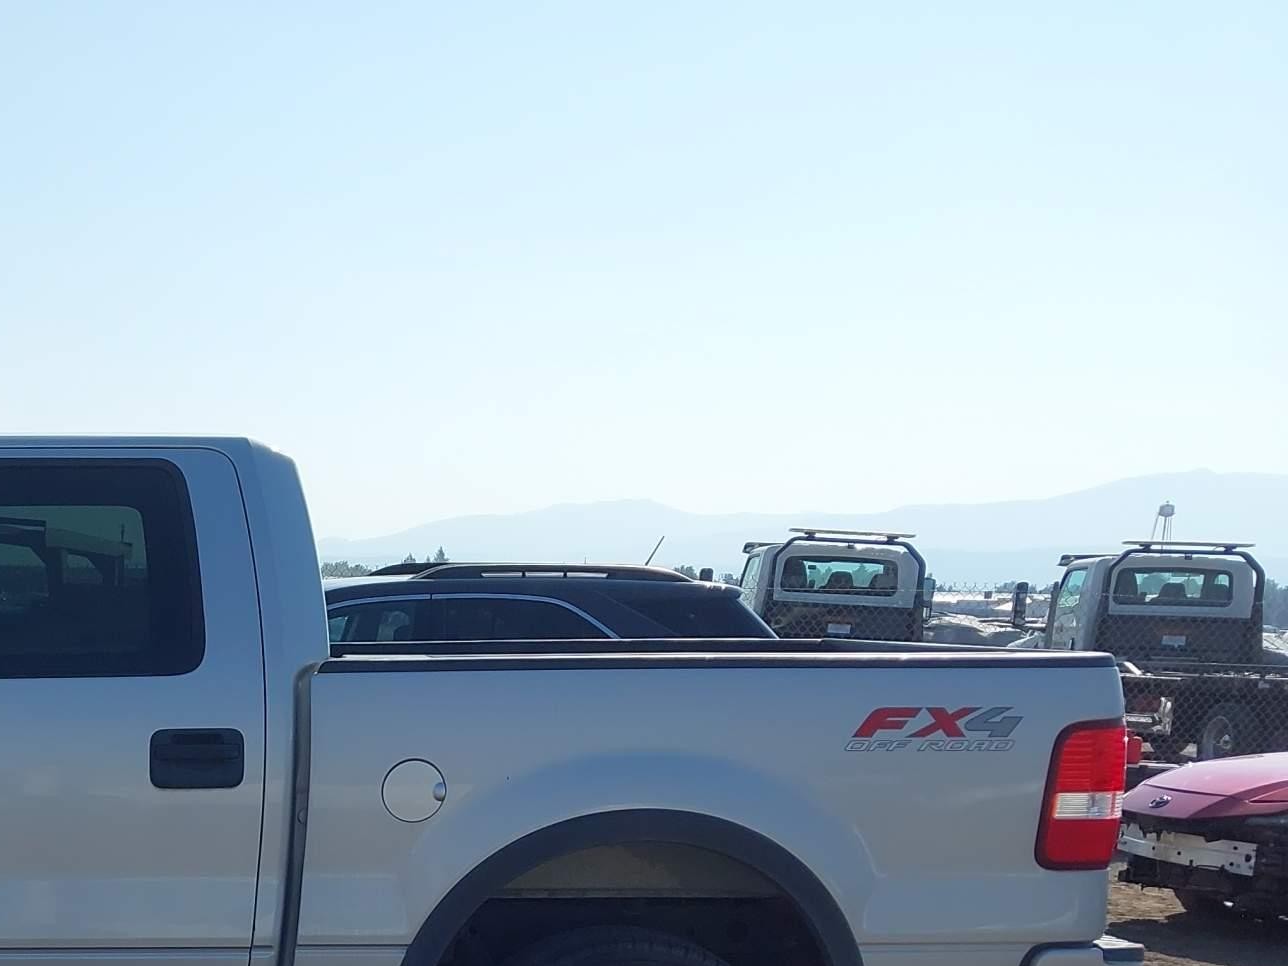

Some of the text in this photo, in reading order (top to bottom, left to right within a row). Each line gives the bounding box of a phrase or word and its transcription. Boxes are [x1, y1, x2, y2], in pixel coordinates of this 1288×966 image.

[851, 707, 1024, 738] FX4
[844, 739, 1015, 751] OFF ROAD
